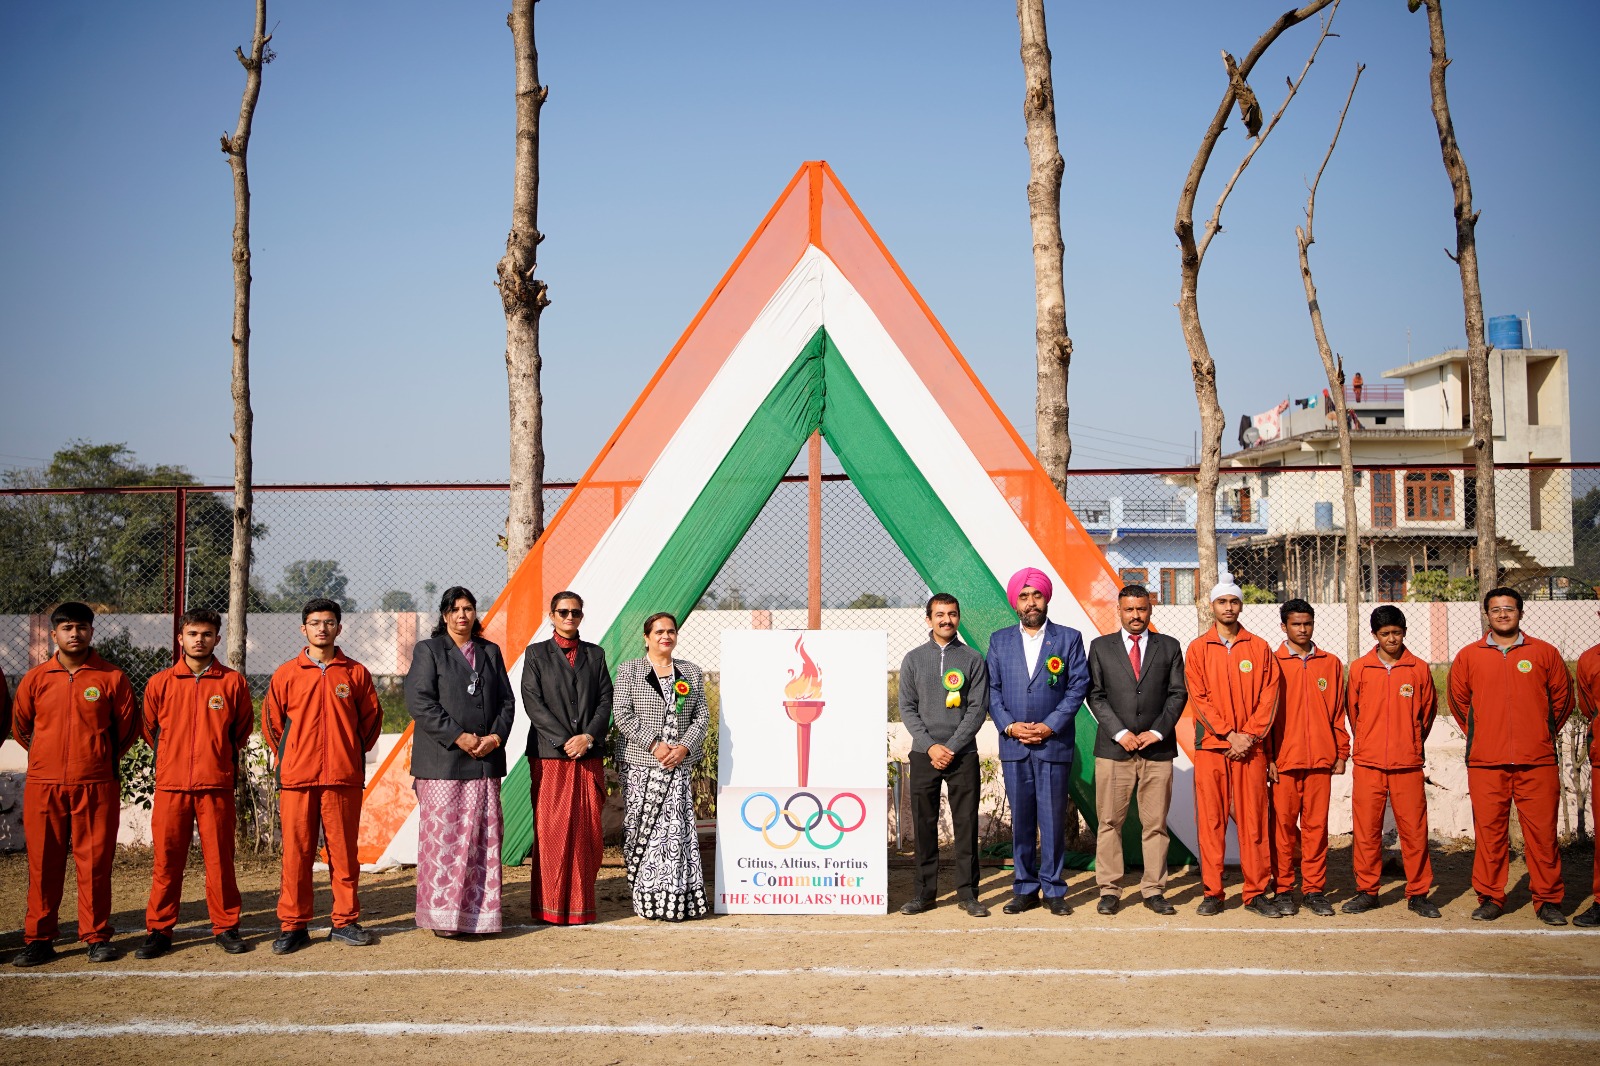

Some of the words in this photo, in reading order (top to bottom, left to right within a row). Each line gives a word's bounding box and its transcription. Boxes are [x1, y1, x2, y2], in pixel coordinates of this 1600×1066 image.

[737, 857, 777, 870] Citius,
[780, 857, 820, 870] Altius,
[824, 857, 868, 869] Fortius
[752, 871, 865, 888] Communiter
[720, 893, 750, 905] THE
[753, 893, 837, 905] SCHOLARS’
[840, 894, 885, 906] HOME
